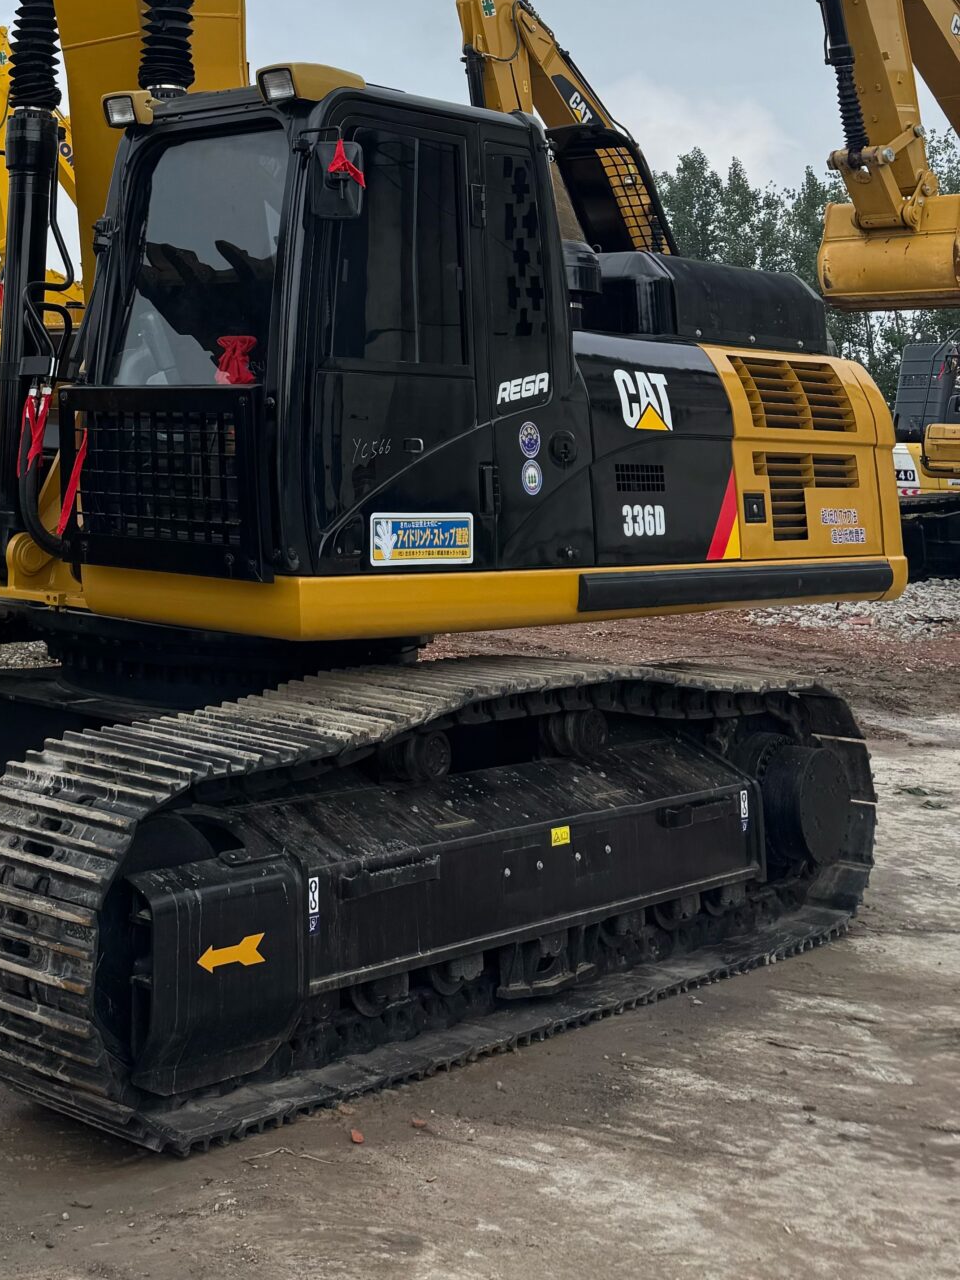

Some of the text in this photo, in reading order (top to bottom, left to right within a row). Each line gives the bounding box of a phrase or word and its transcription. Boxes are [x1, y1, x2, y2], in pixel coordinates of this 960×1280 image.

[569, 91, 594, 124] CAT
[496, 372, 550, 405] REGA
[613, 369, 674, 431] CAT
[622, 504, 666, 537] 336D
